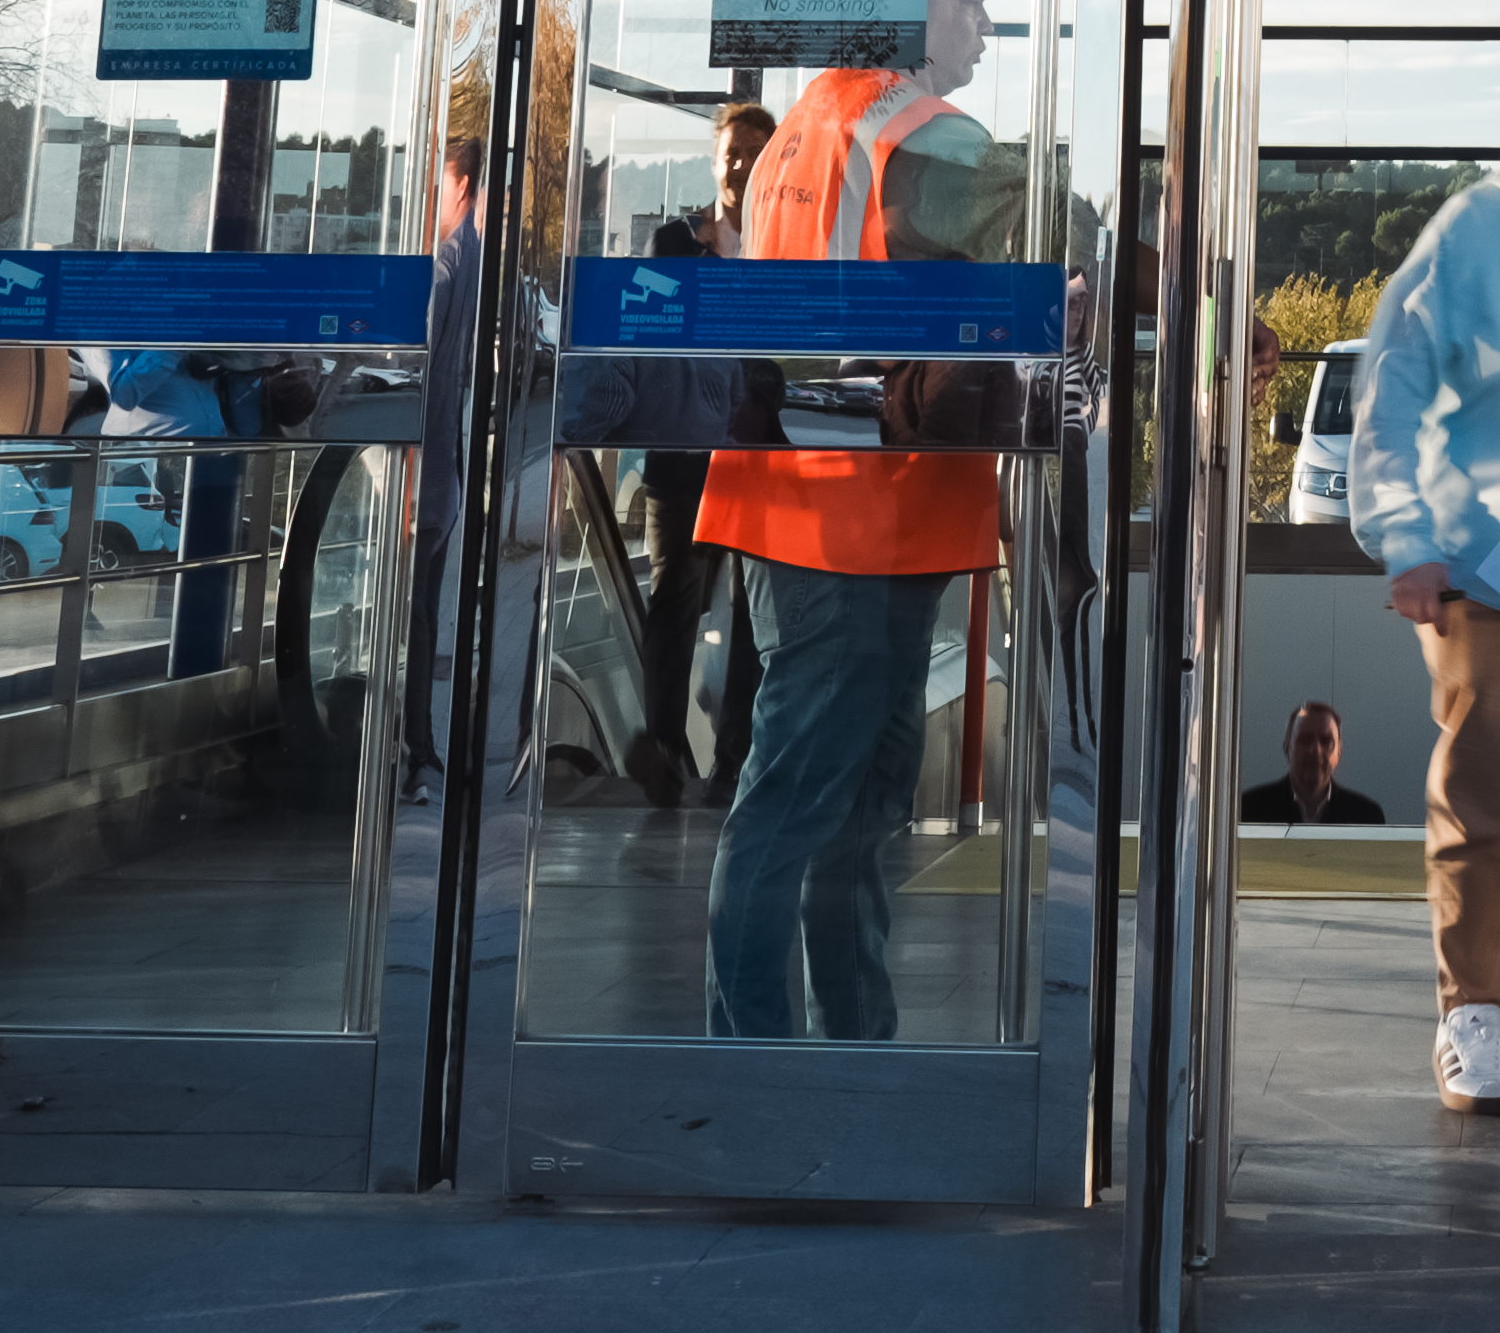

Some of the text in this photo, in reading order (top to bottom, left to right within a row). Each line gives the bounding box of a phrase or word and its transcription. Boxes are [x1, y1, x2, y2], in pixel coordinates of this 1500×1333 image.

[151, 0, 215, 9] COMPROMISO
[217, 0, 237, 8] CON
[114, 22, 164, 31] PROGRESO
[110, 60, 297, 71] EMPRESA CERTIFICADA
[24, 296, 47, 305] ZONA
[662, 304, 685, 313] ZONA
[620, 314, 684, 324] VIDEOVIGILADA
